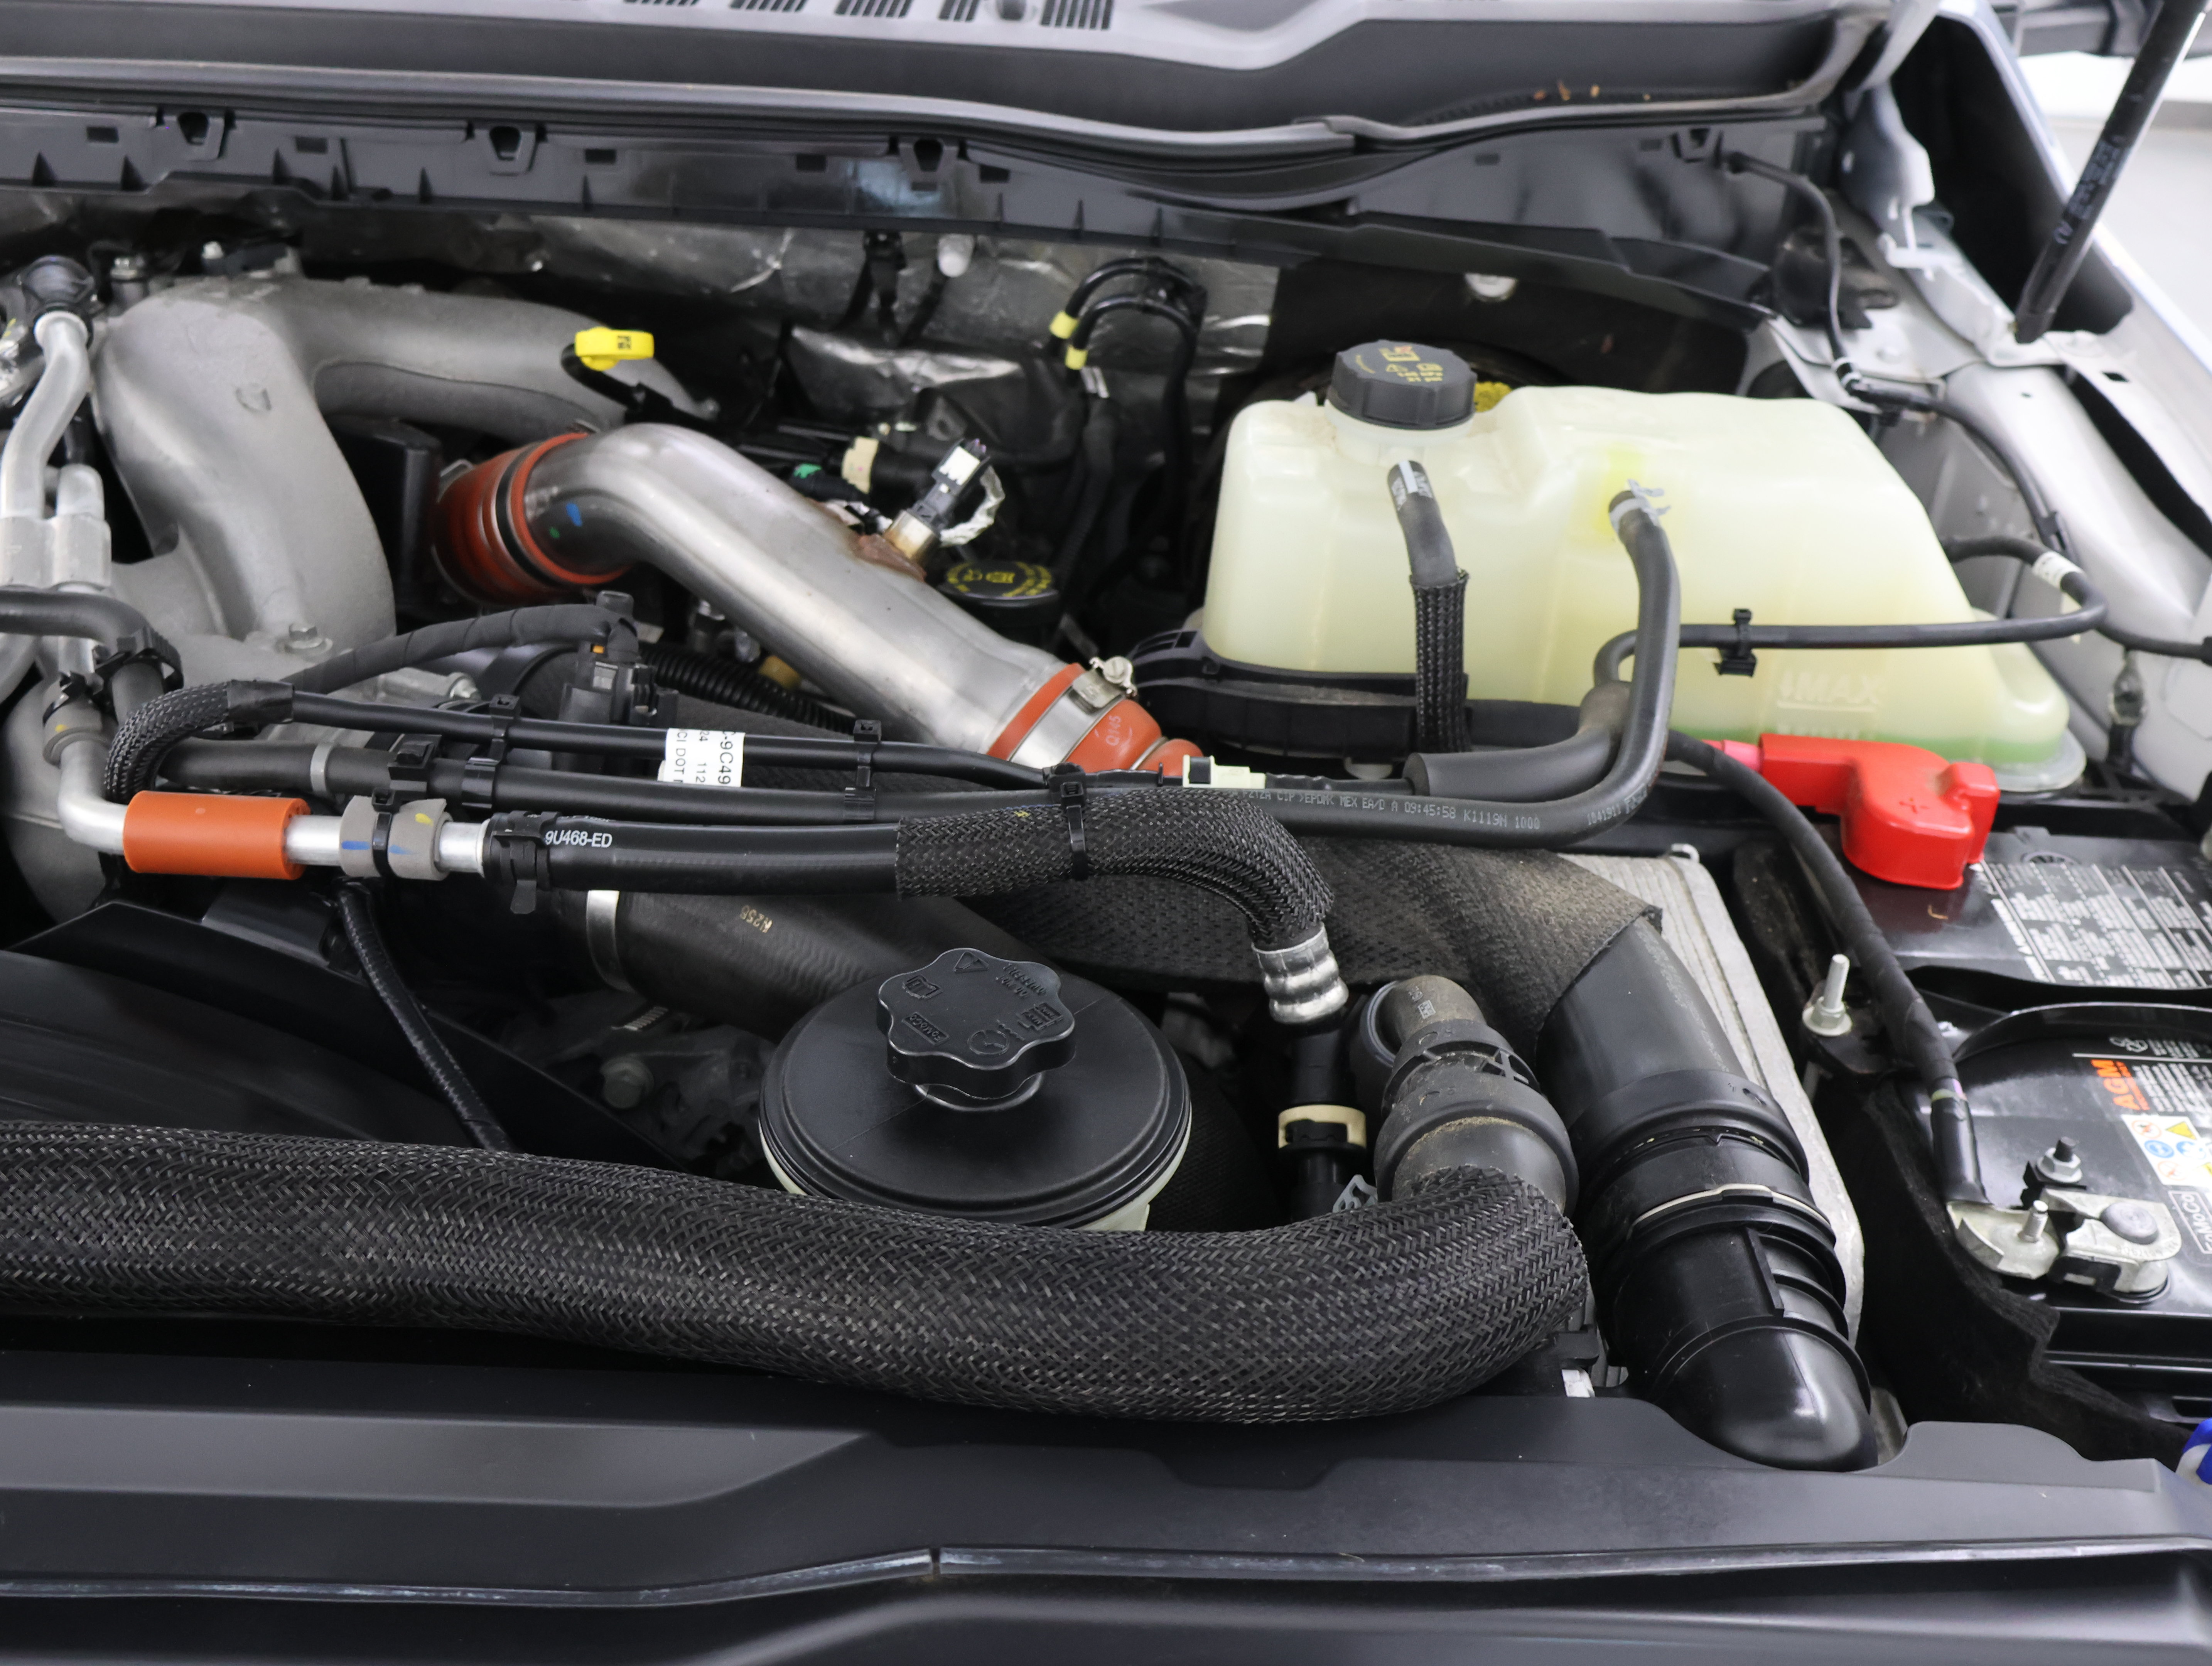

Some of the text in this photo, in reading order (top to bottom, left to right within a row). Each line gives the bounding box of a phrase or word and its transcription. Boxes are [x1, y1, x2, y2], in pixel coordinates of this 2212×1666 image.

[1795, 672, 1885, 705] MAX
[673, 748, 686, 774] DOT
[695, 762, 707, 783] 112
[1340, 795, 1358, 808] MEX
[1391, 799, 1398, 812] A
[1404, 801, 1456, 819] 09:45:58
[544, 830, 613, 848] 9U468-ED
[2091, 1059, 2140, 1111] AGM
